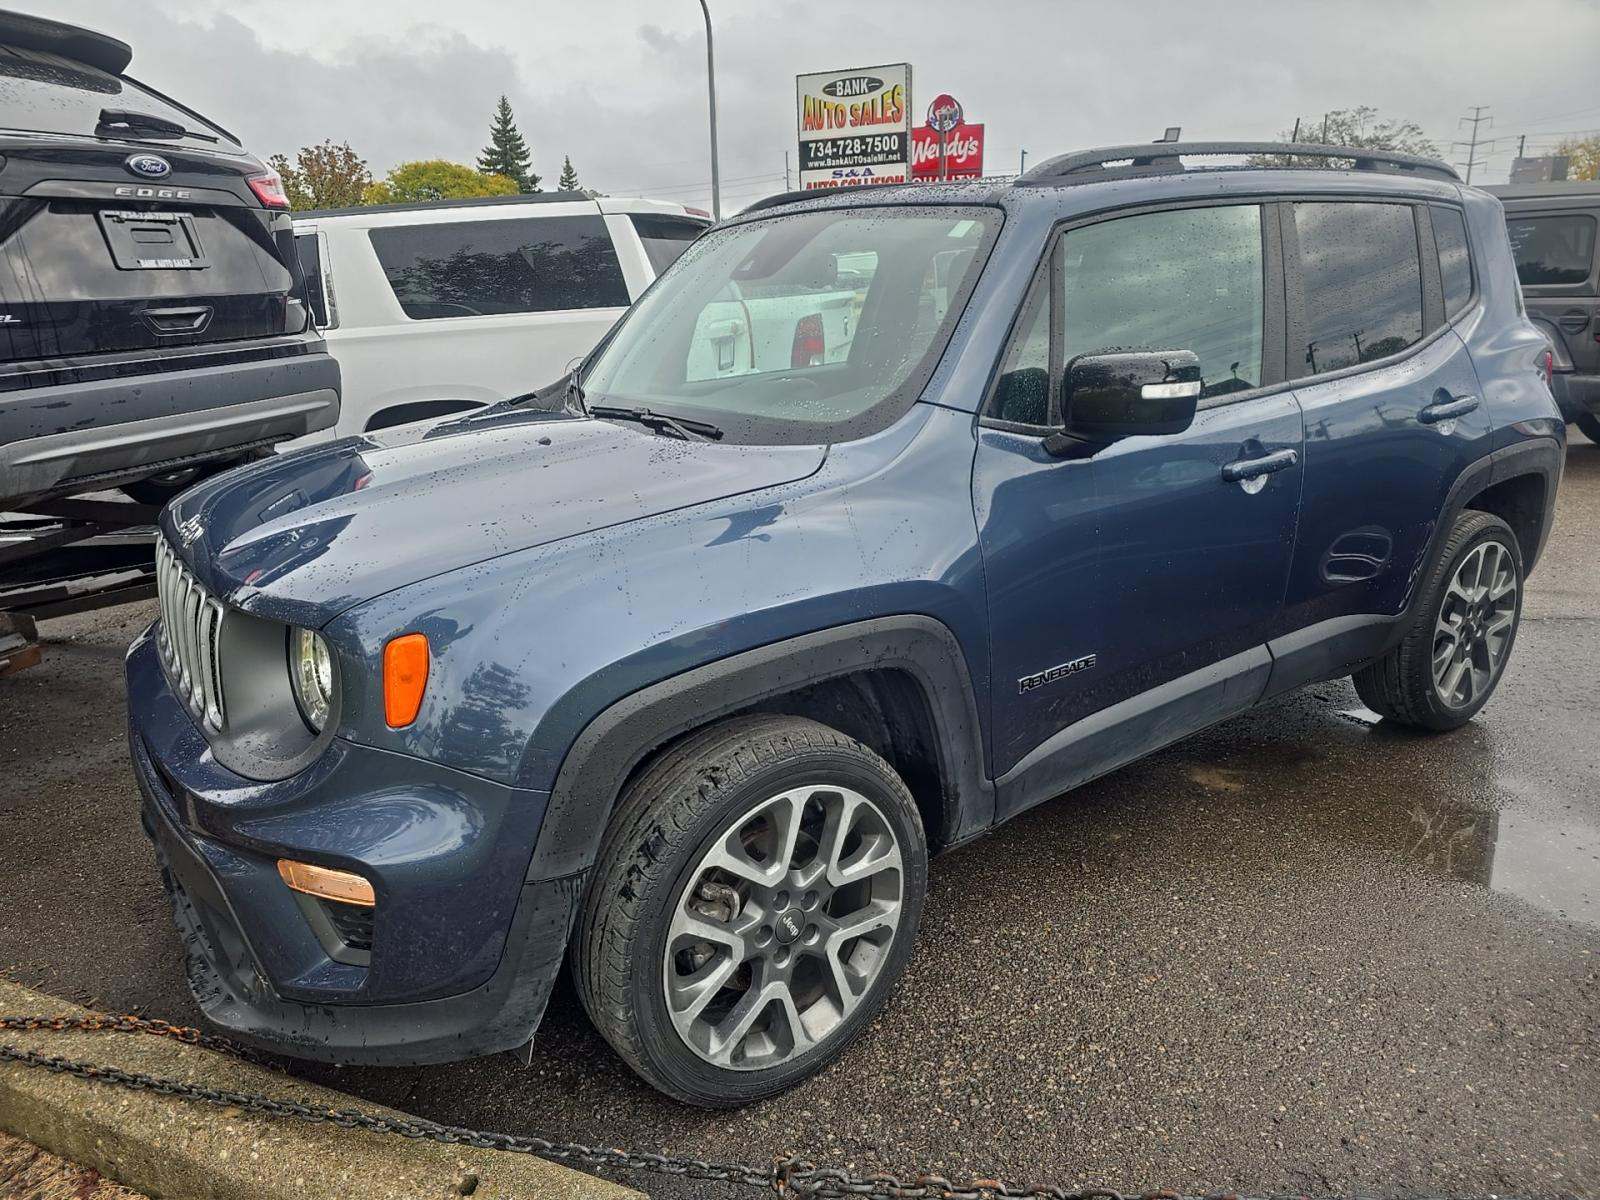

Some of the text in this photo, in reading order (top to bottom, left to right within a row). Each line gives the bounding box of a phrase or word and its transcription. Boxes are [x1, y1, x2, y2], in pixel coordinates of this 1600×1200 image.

[836, 78, 869, 96] BANK
[802, 84, 904, 132] AUTO SALES
[808, 135, 899, 158] 734-728-7500
[912, 131, 979, 166] Wendy's
[139, 158, 165, 173] Ford
[832, 167, 875, 179] S & A
[114, 187, 192, 199] EDGE
[1018, 653, 1097, 695] RENEGADE
[782, 916, 799, 937] Jeep
